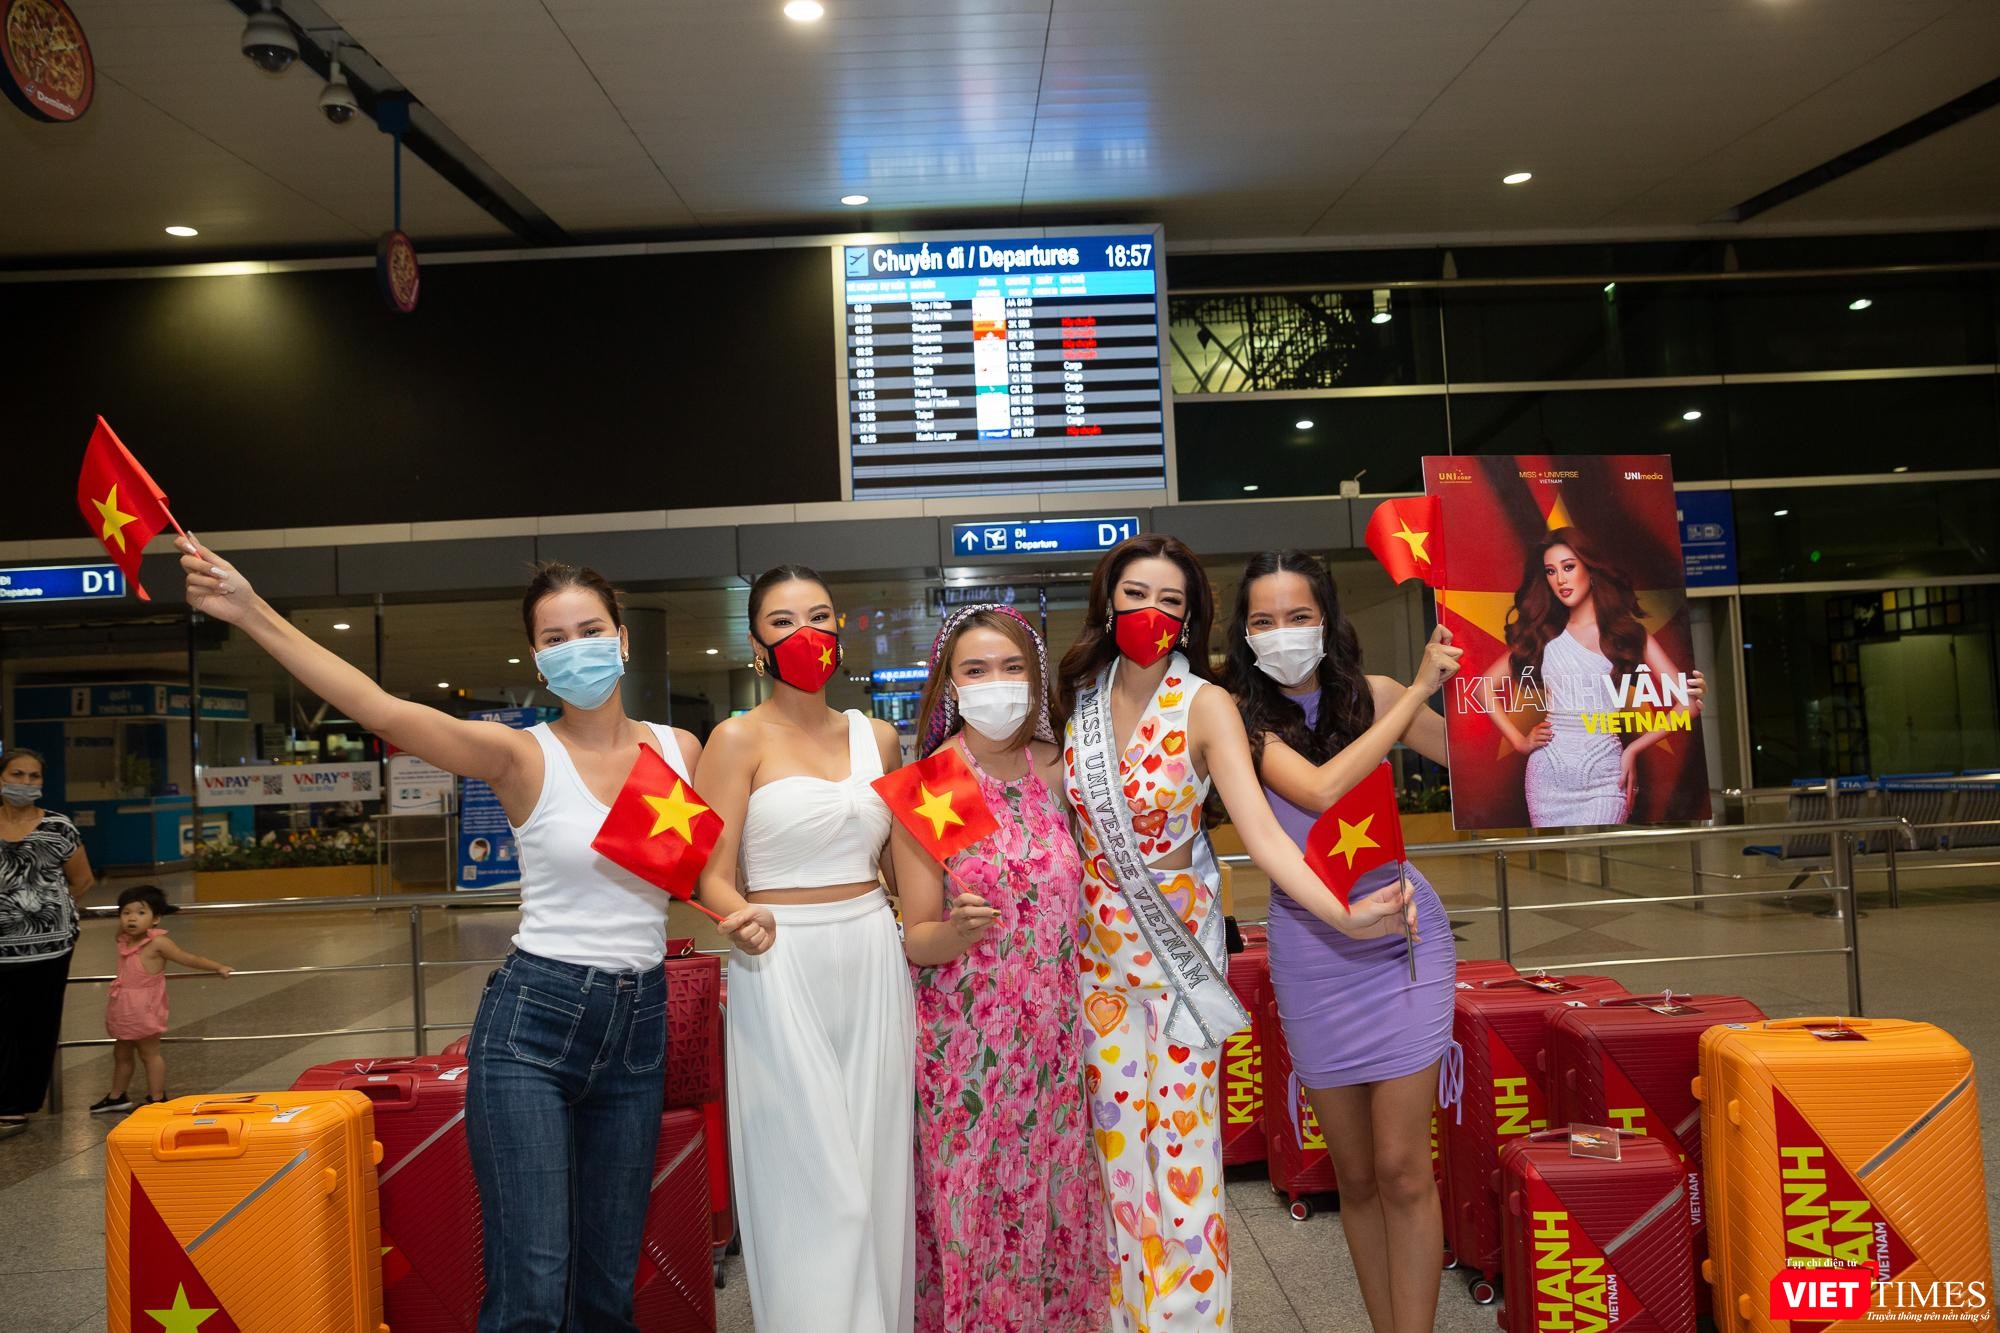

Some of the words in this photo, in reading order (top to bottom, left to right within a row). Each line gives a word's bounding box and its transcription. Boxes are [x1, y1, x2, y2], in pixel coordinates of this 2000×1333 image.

[947, 246, 964, 269] đi
[979, 244, 1079, 273] Departures
[1105, 243, 1152, 268] 18:57
[1014, 540, 1058, 551] Departure
[1098, 523, 1130, 546] D1
[82, 570, 115, 593] D1
[1455, 665, 1602, 714] KHÁNH
[1601, 663, 1690, 709] VÂN
[1081, 688, 1102, 747] MISS
[1580, 709, 1692, 734] VIETNAM
[1840, 781, 1862, 789] TIA
[1085, 751, 1139, 881] UNIVERSE
[1134, 886, 1210, 990] VIETNAM
[1227, 1011, 1254, 1124] KHAN
[1688, 1172, 1702, 1225] VIETNAM
[1532, 1211, 1574, 1333] HANH
[1874, 1222, 1891, 1282] VIETNAM
[1571, 1257, 1609, 1333] VAN
[1606, 1274, 1619, 1324] VIETNAM
